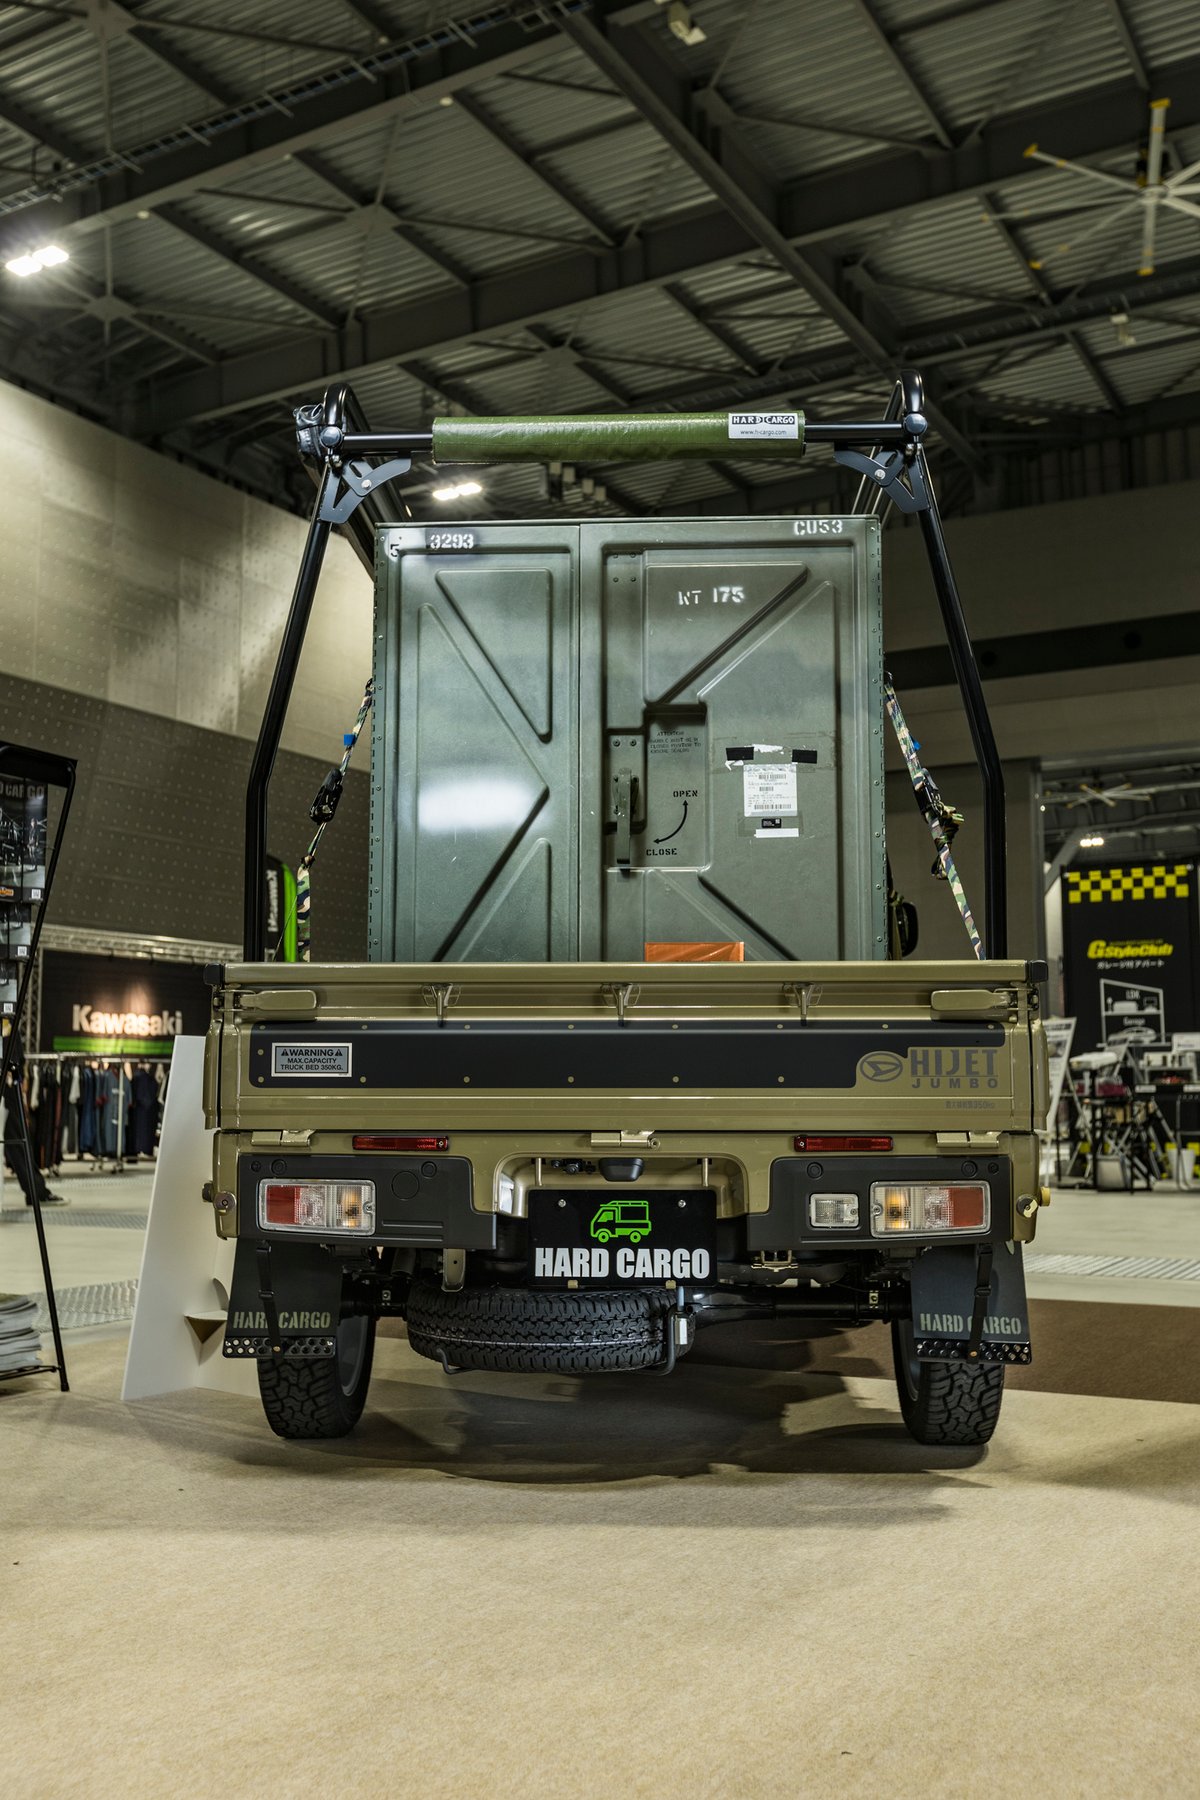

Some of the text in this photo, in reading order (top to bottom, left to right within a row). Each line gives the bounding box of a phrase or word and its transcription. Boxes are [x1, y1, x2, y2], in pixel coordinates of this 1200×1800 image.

[733, 416, 794, 424] HARD CARGO
[793, 519, 843, 535] CU53
[430, 534, 474, 550] 3293
[713, 586, 745, 602] 175
[673, 790, 698, 798] OPEN
[646, 848, 678, 856] CLOSE
[72, 1004, 183, 1036] Kawasaki
[910, 1049, 998, 1076] HIJET
[911, 1078, 998, 1089] JUMBO
[534, 1247, 710, 1279] HARD CARGO
[233, 1312, 331, 1329] HAR CARGO
[920, 1313, 964, 1333] HARD
